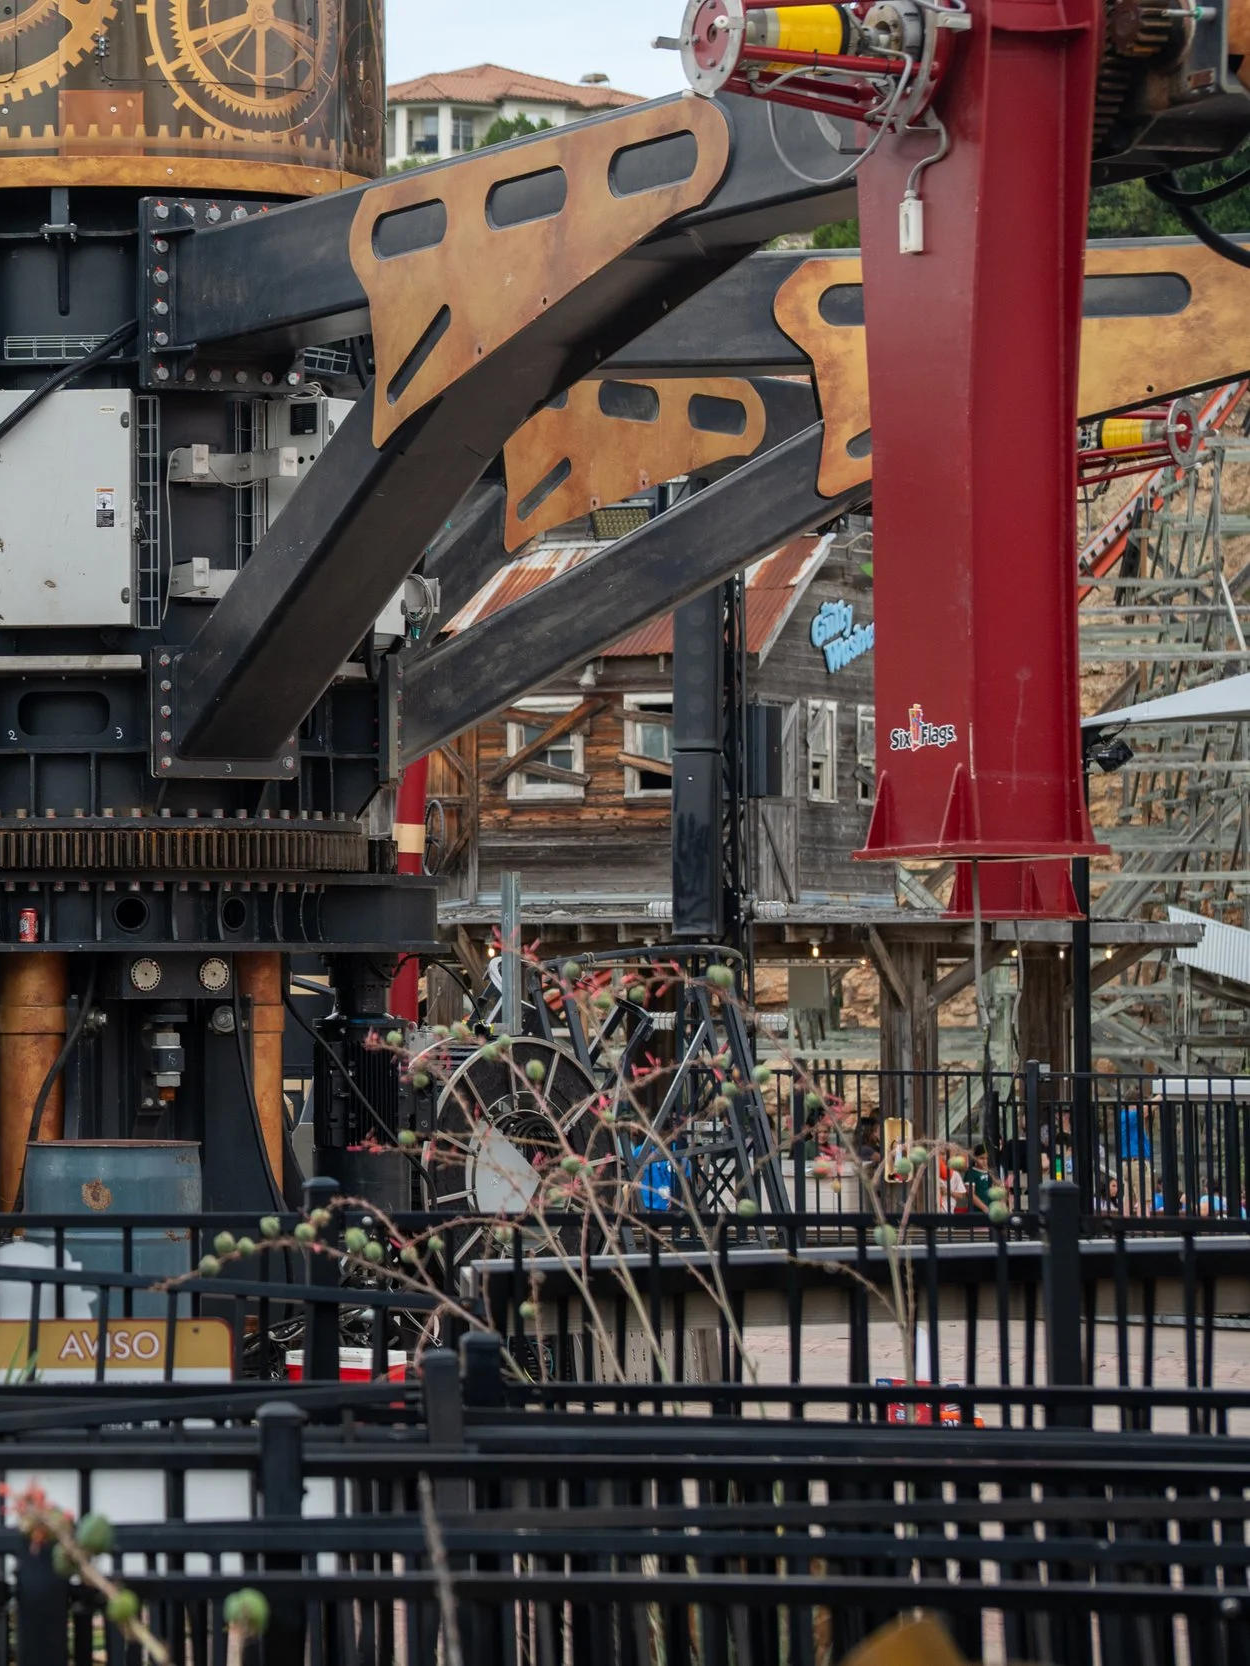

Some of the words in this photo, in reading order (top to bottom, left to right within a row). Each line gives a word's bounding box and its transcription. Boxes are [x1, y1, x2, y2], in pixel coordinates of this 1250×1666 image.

[8, 729, 18, 741] 2
[115, 726, 123, 740] 3
[890, 728, 911, 751] Six
[921, 722, 957, 748] Flags
[59, 1330, 160, 1361] AVISO
